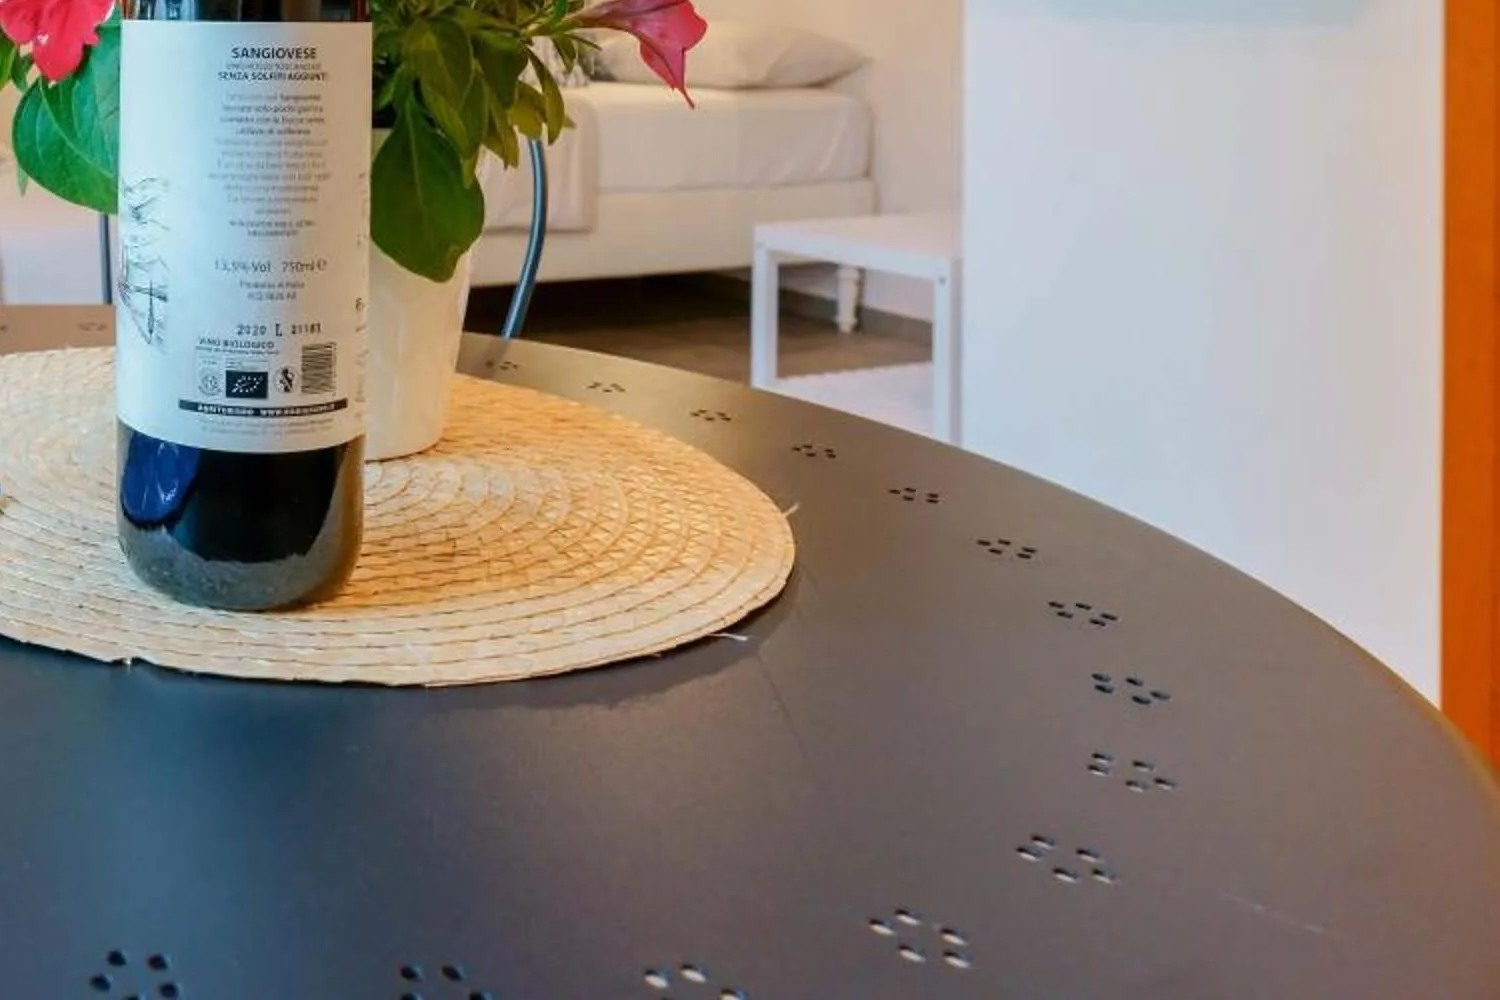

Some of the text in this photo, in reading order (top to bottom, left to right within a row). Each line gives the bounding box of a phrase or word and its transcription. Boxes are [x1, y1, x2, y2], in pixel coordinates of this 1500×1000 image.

[231, 47, 317, 60] SANGIOVESE
[218, 71, 249, 81] SENZA
[252, 260, 271, 273] Vol
[275, 323, 283, 336] L
